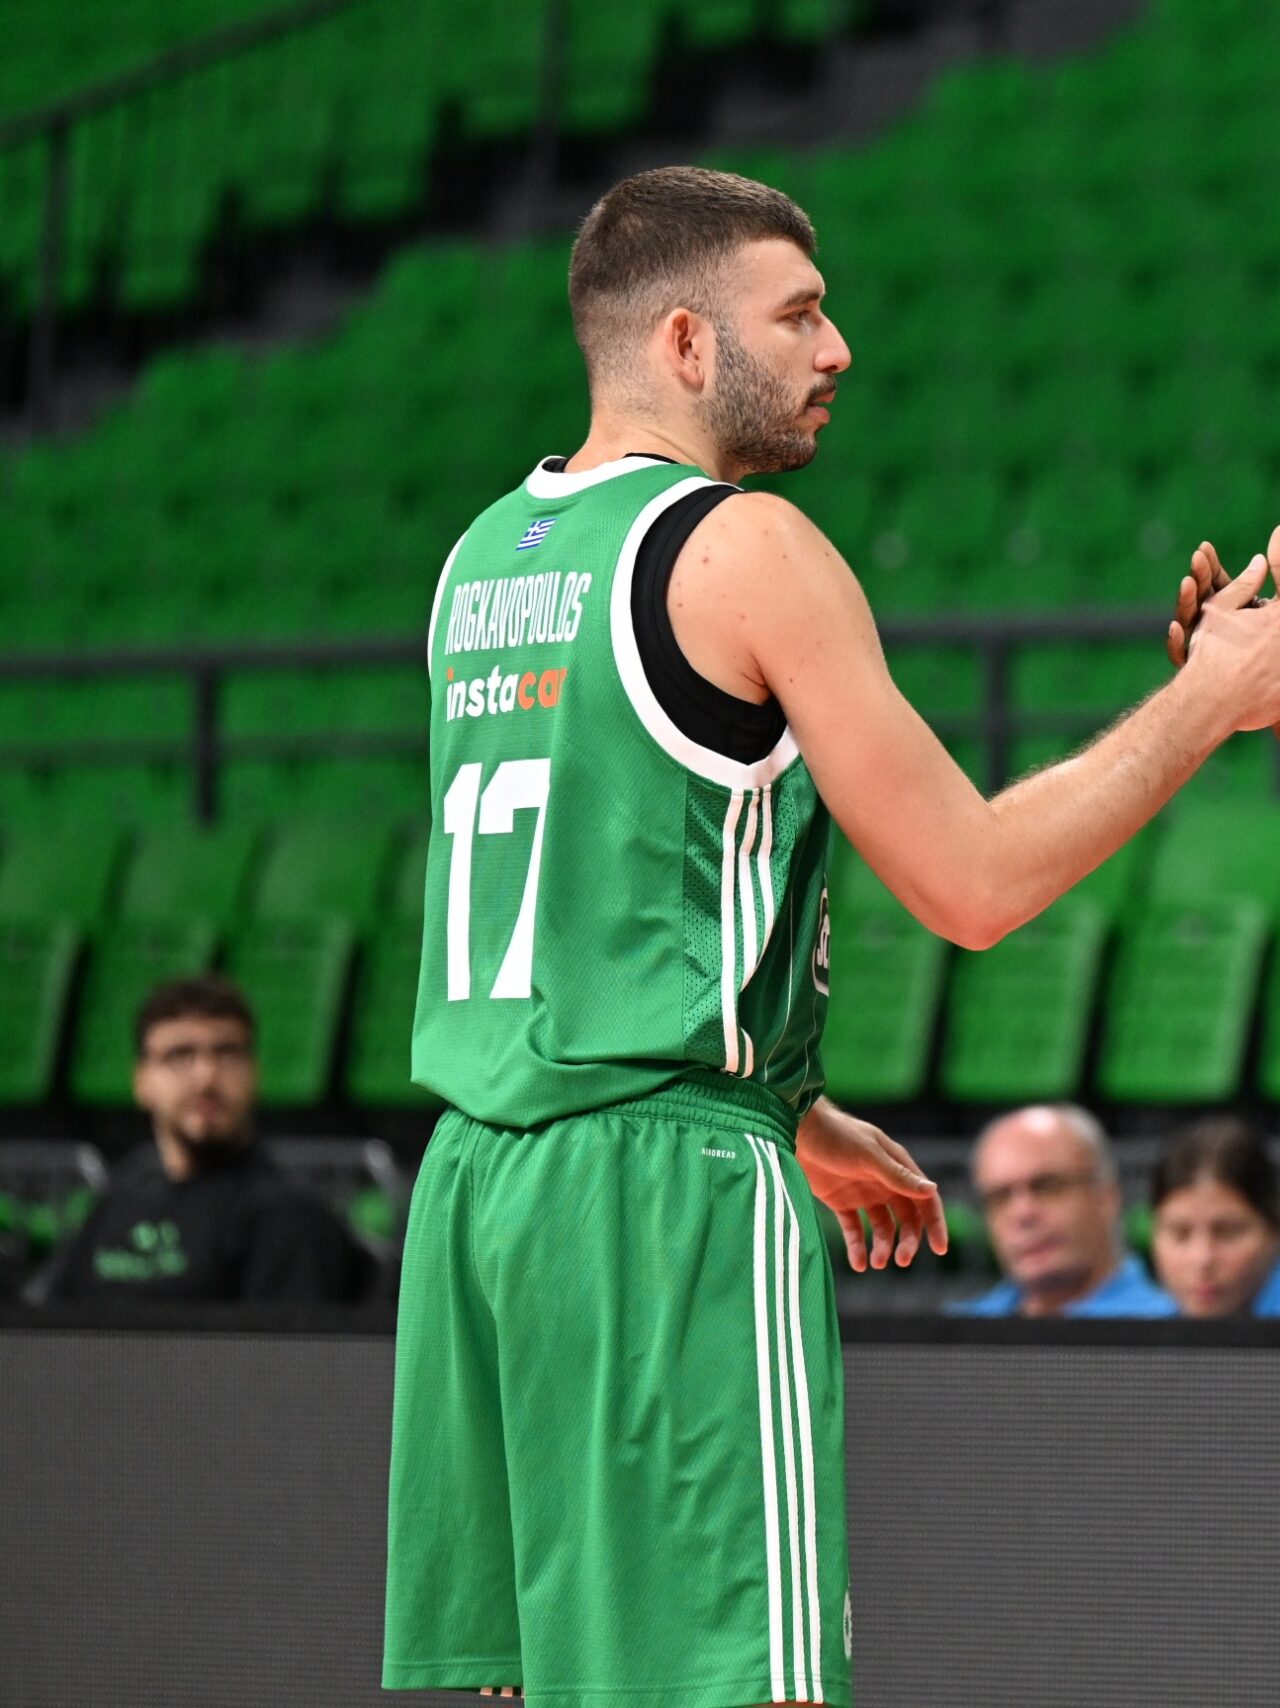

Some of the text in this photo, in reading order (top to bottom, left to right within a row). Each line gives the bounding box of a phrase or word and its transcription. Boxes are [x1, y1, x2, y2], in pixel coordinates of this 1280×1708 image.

[445, 571, 592, 655] ROGKAVOPOULOS
[446, 665, 568, 722] instacar
[444, 758, 551, 1001] 17
